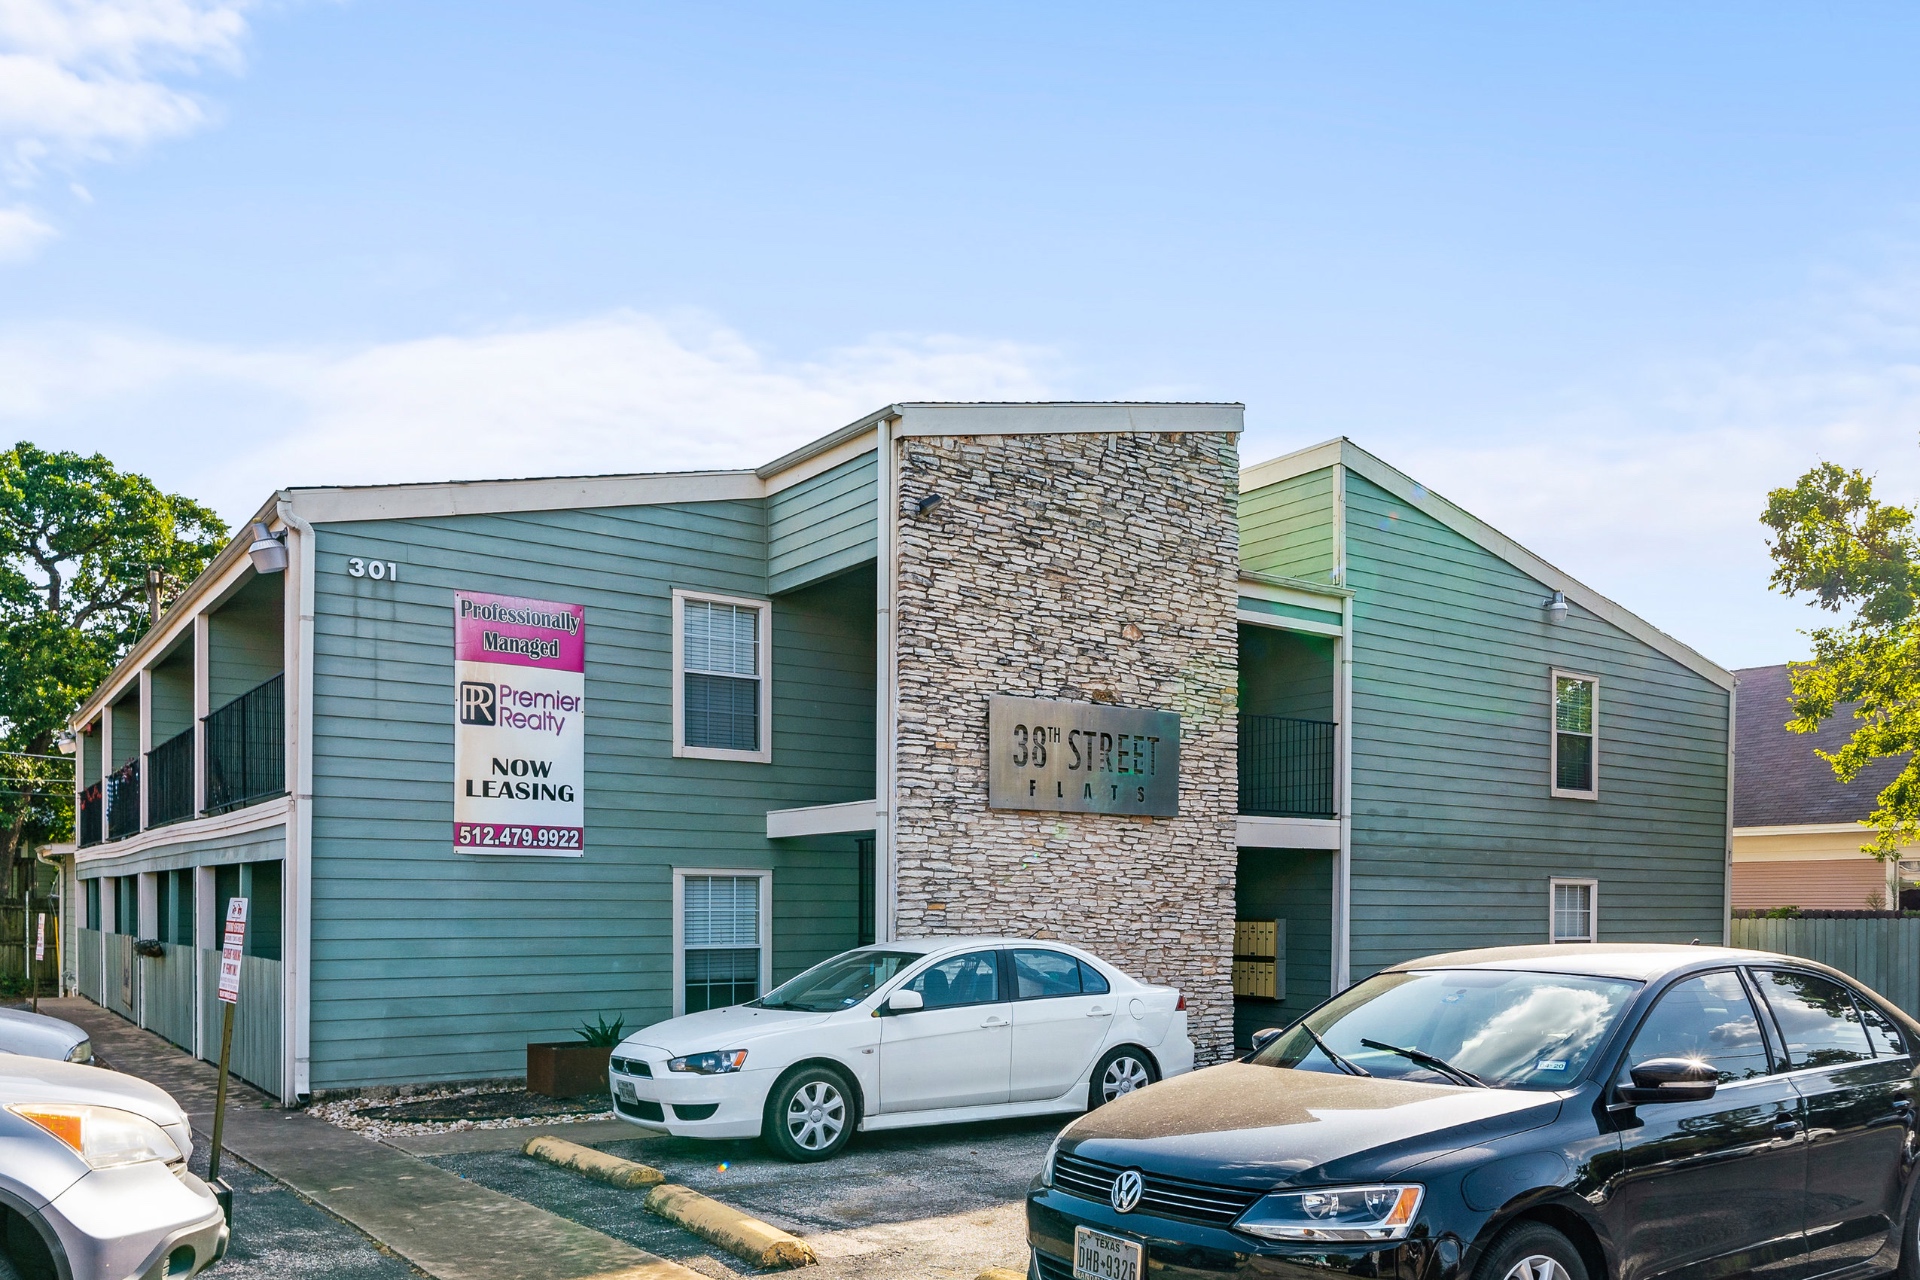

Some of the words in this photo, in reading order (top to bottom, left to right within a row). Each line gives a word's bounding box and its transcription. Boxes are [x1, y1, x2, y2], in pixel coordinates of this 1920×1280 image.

[349, 558, 397, 581] 301
[460, 599, 580, 635] Professionally
[483, 631, 560, 659] Managed
[499, 684, 581, 712] Premier
[499, 706, 565, 736] Realty
[1068, 729, 1160, 776] STREET
[492, 757, 553, 779] NOW
[465, 779, 575, 803] LEASING
[459, 826, 579, 848] 512.479.9922
[1095, 1237, 1121, 1253] TEXAS
